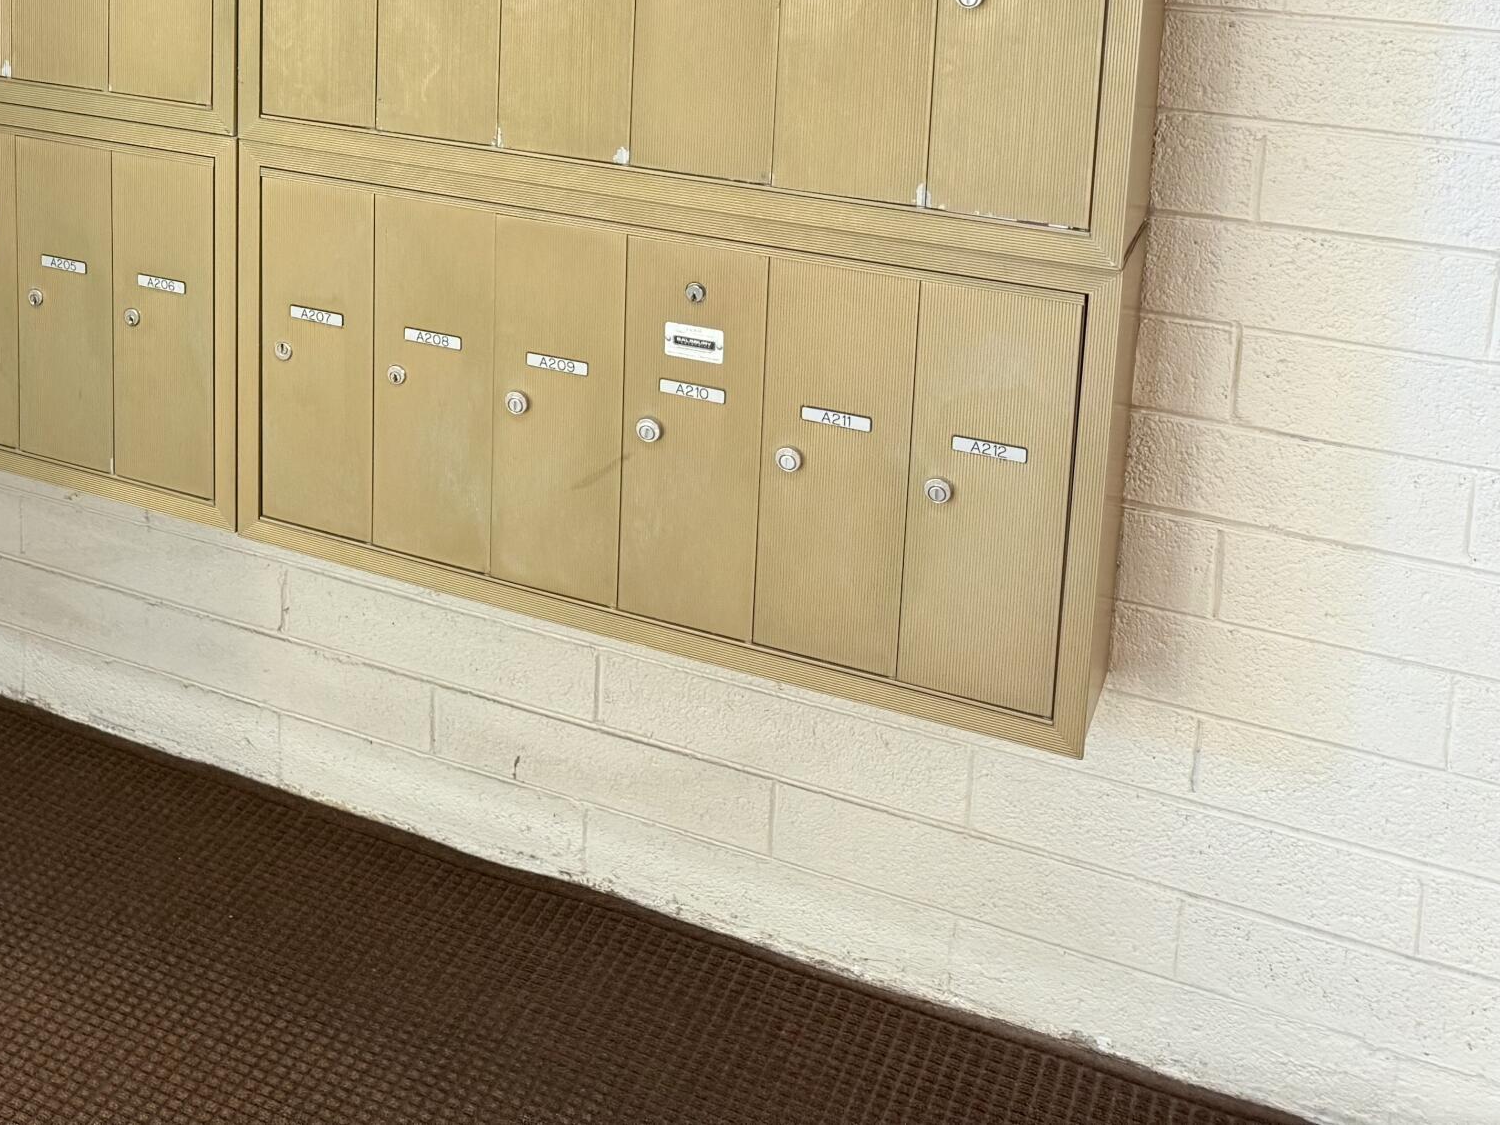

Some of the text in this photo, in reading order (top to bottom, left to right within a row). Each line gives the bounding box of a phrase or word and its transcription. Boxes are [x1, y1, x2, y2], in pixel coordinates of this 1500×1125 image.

[50, 258, 77, 271] A205
[147, 277, 176, 291] A206
[301, 309, 332, 323] A207
[416, 332, 450, 347] A208
[539, 356, 576, 373] A209
[675, 384, 709, 400] A210
[821, 412, 852, 428] A211
[970, 441, 1007, 459] A212
